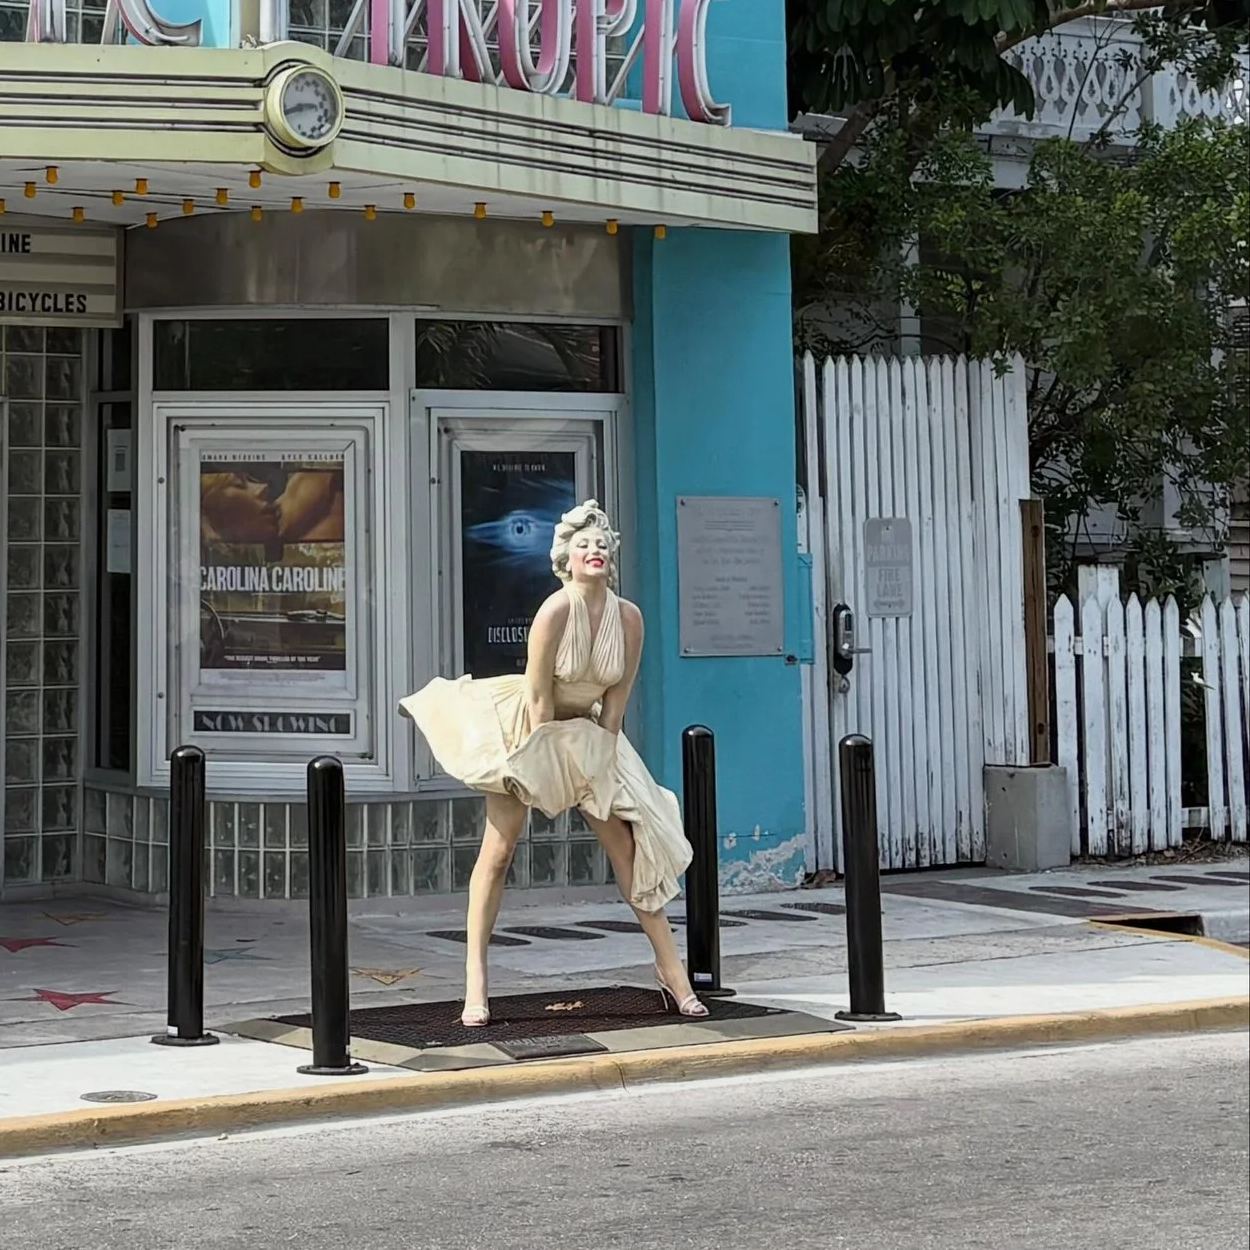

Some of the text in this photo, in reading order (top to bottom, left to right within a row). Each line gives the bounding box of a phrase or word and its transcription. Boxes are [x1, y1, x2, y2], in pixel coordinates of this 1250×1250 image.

[200, 566, 346, 592] CAROLINA CAROLINE
[878, 568, 900, 582] FIRE
